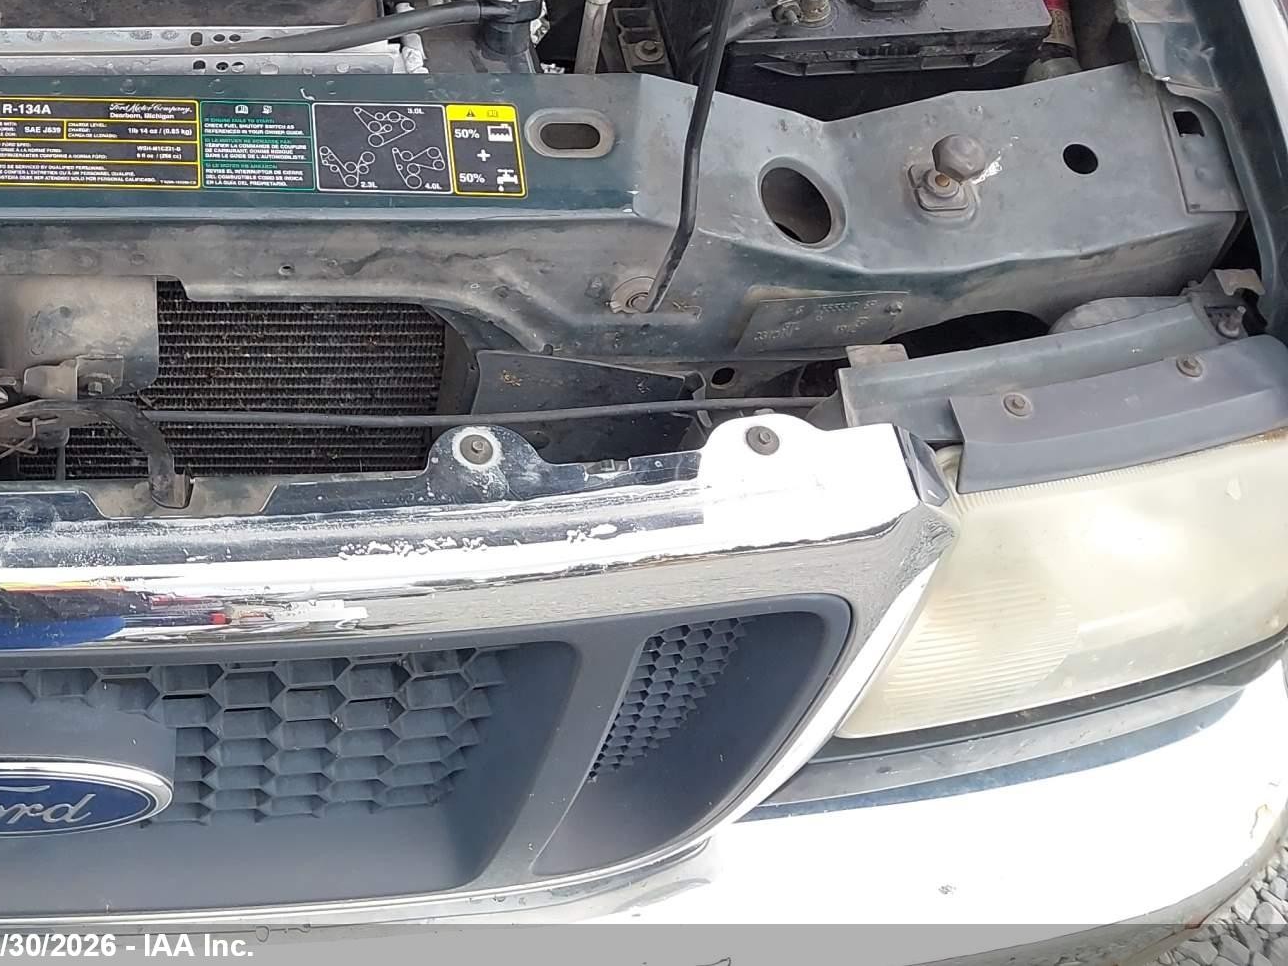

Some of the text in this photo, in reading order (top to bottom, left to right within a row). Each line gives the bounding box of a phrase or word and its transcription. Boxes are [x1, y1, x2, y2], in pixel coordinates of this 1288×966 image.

[2, 104, 51, 114] R-134A
[109, 103, 129, 112] Ford
[454, 129, 480, 139] 50%
[459, 173, 486, 183] 50%
